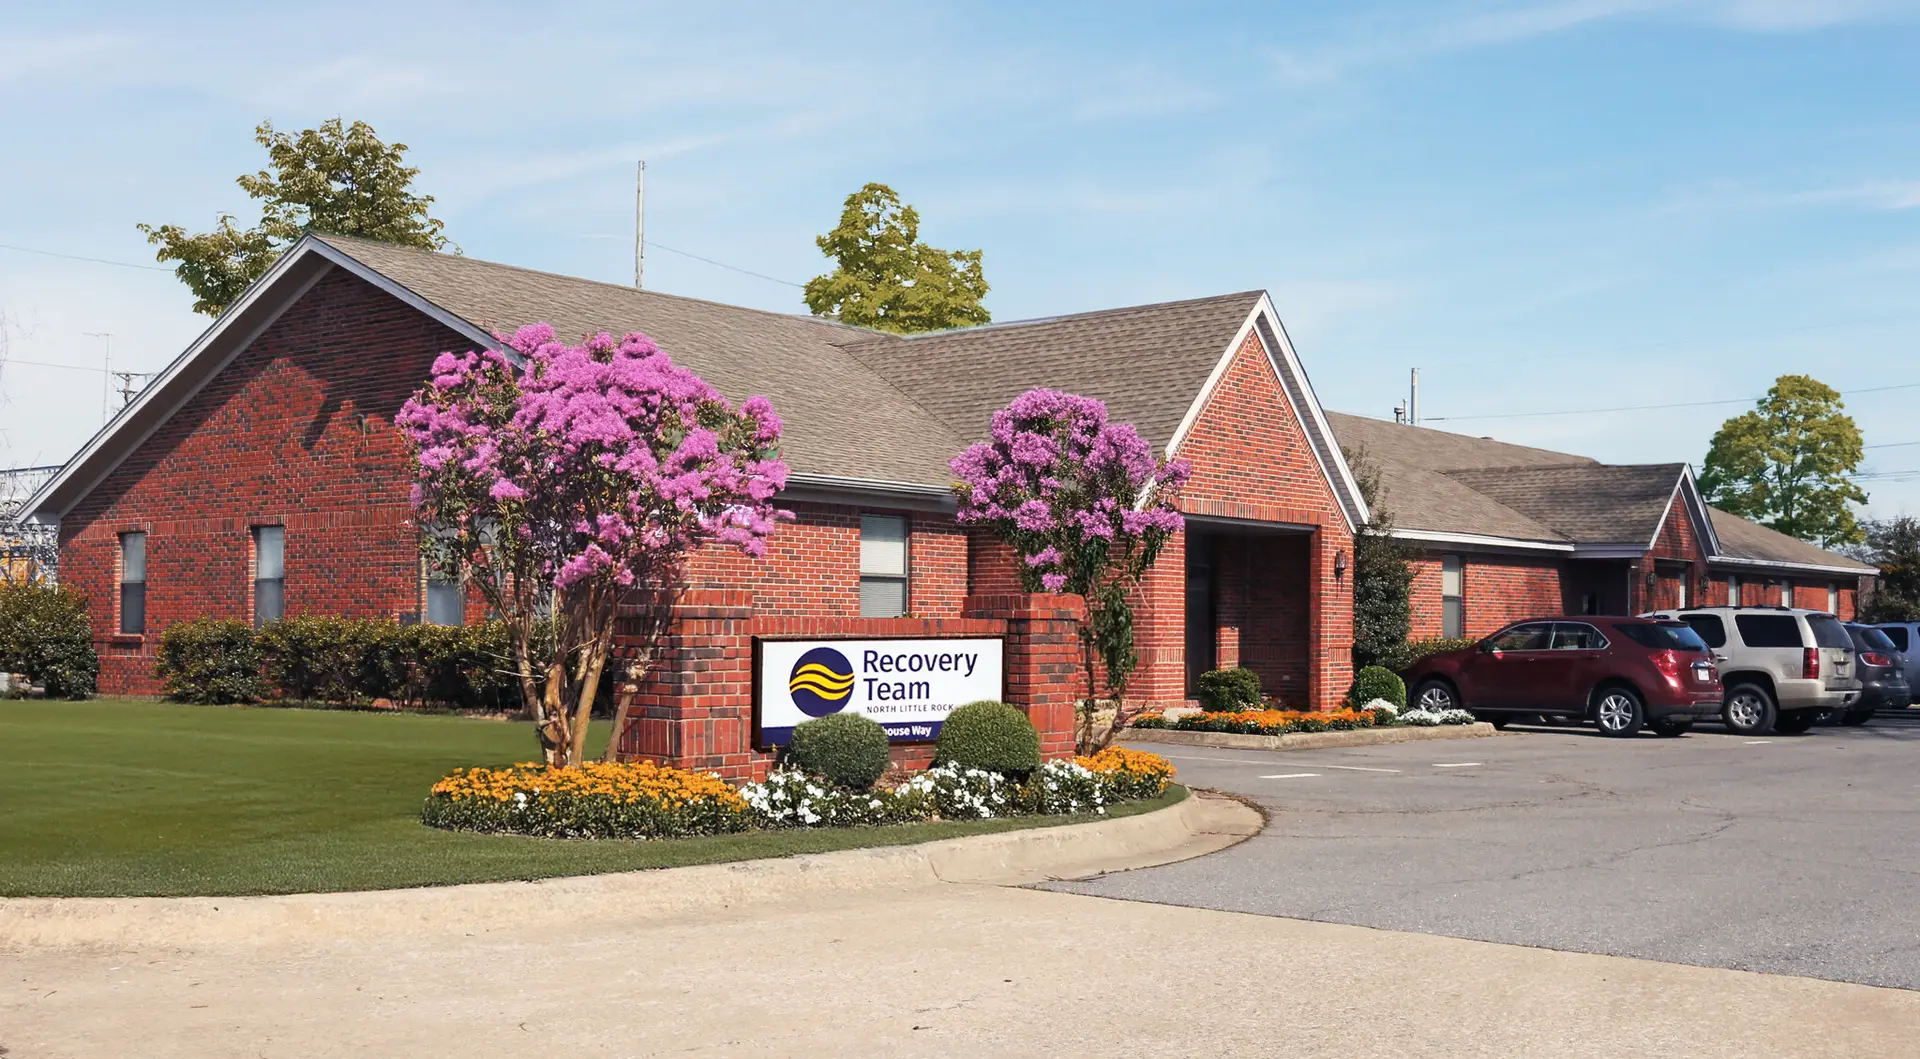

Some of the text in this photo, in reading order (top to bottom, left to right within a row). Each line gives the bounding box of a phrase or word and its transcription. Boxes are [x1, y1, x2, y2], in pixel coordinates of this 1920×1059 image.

[863, 650, 978, 677] Recovery
[863, 678, 930, 701] Team
[866, 703, 954, 714] NORTH LITTLE ROCK
[911, 725, 932, 737] Way
